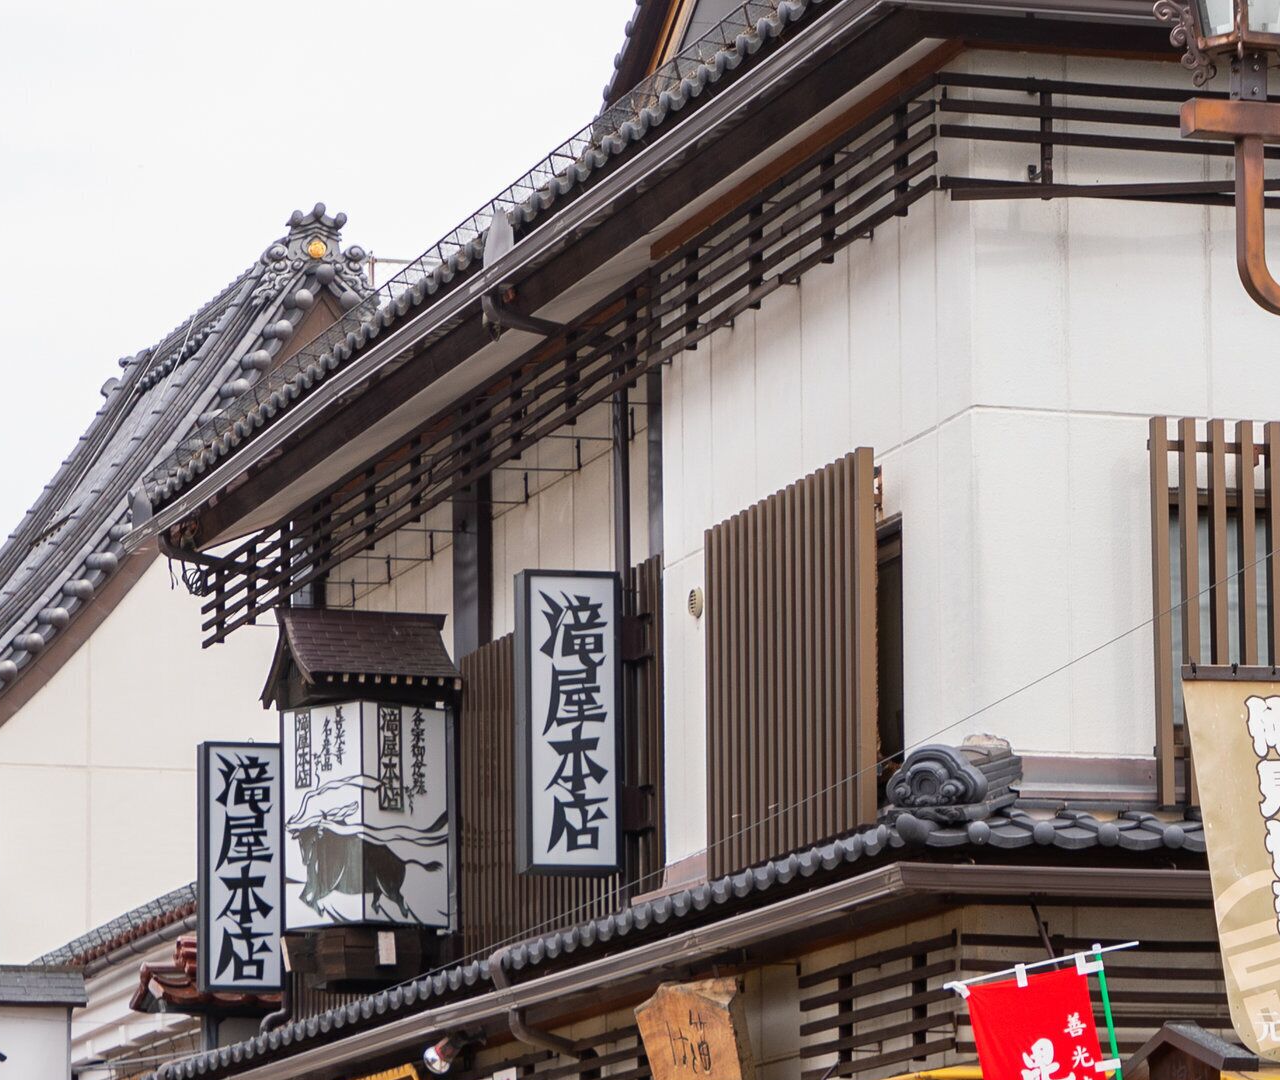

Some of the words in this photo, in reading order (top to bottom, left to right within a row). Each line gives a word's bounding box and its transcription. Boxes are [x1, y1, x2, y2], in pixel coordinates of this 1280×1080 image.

[538, 589, 609, 853] 滝屋本店
[215, 753, 275, 983] 滝屋本店
